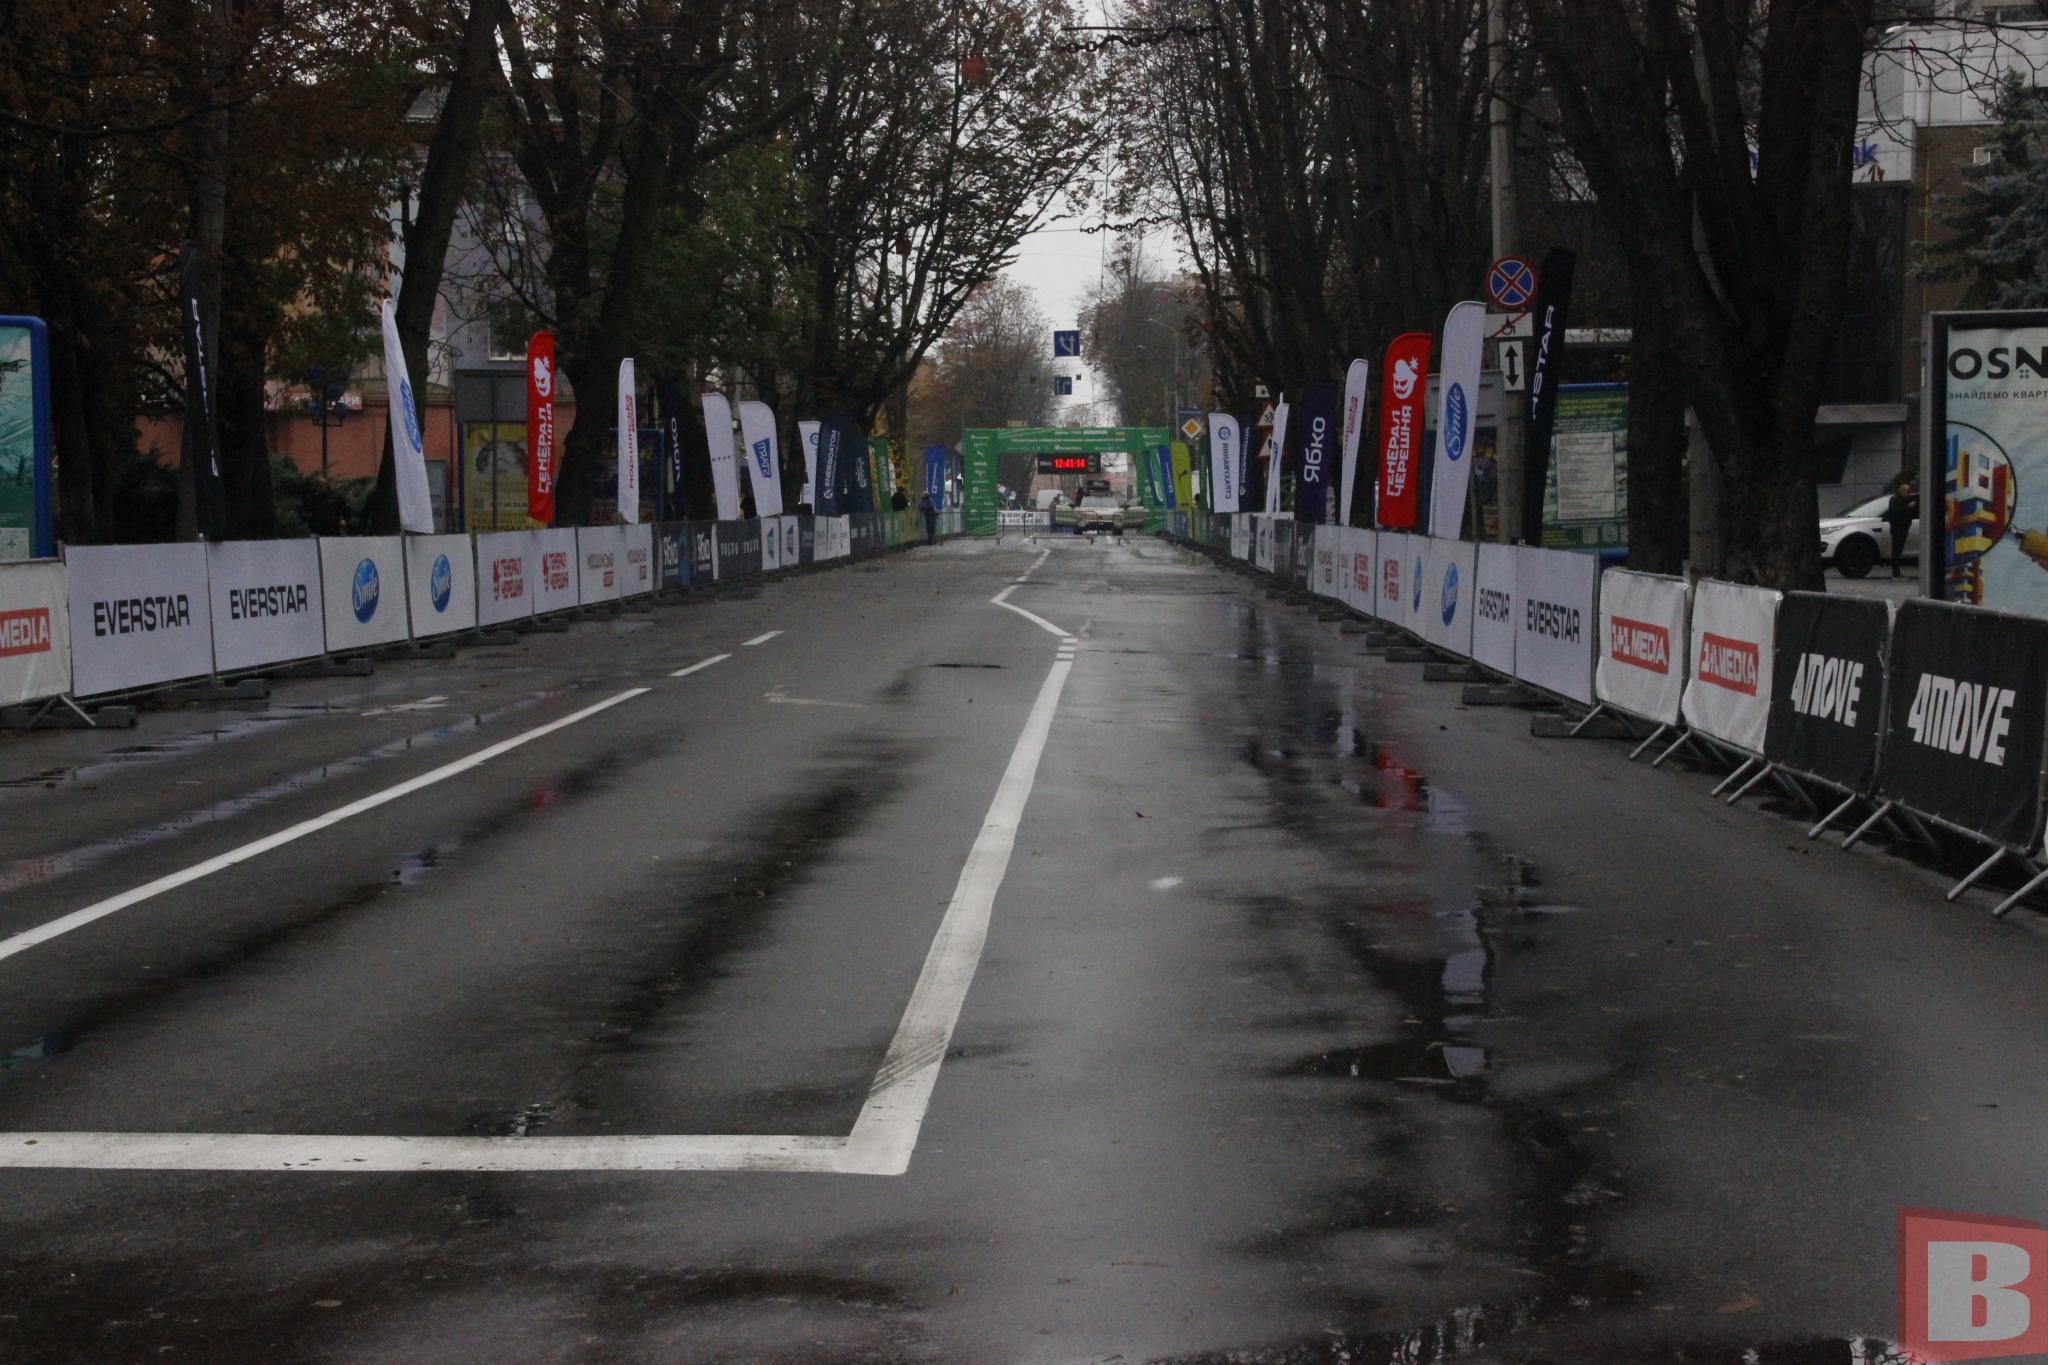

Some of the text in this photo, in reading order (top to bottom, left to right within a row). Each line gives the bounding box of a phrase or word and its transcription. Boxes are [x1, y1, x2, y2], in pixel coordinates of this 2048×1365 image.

[1948, 390, 2009, 401] ЗНАЙДЕМО
[1446, 387, 1462, 455] Smile
[1304, 416, 1326, 483] Ябко
[1386, 410, 1401, 496] ГЕНЕРАЛ
[1392, 405, 1413, 497] ЧЕРЕШНЯ
[93, 593, 190, 637] EVERSTAR
[230, 583, 308, 620] EVERSTAR
[1479, 587, 1511, 624] EVERSTAR
[1527, 598, 1581, 645] EVERSTAR
[1631, 628, 1667, 667] MEDIA
[1907, 672, 2017, 767] 4MOVE
